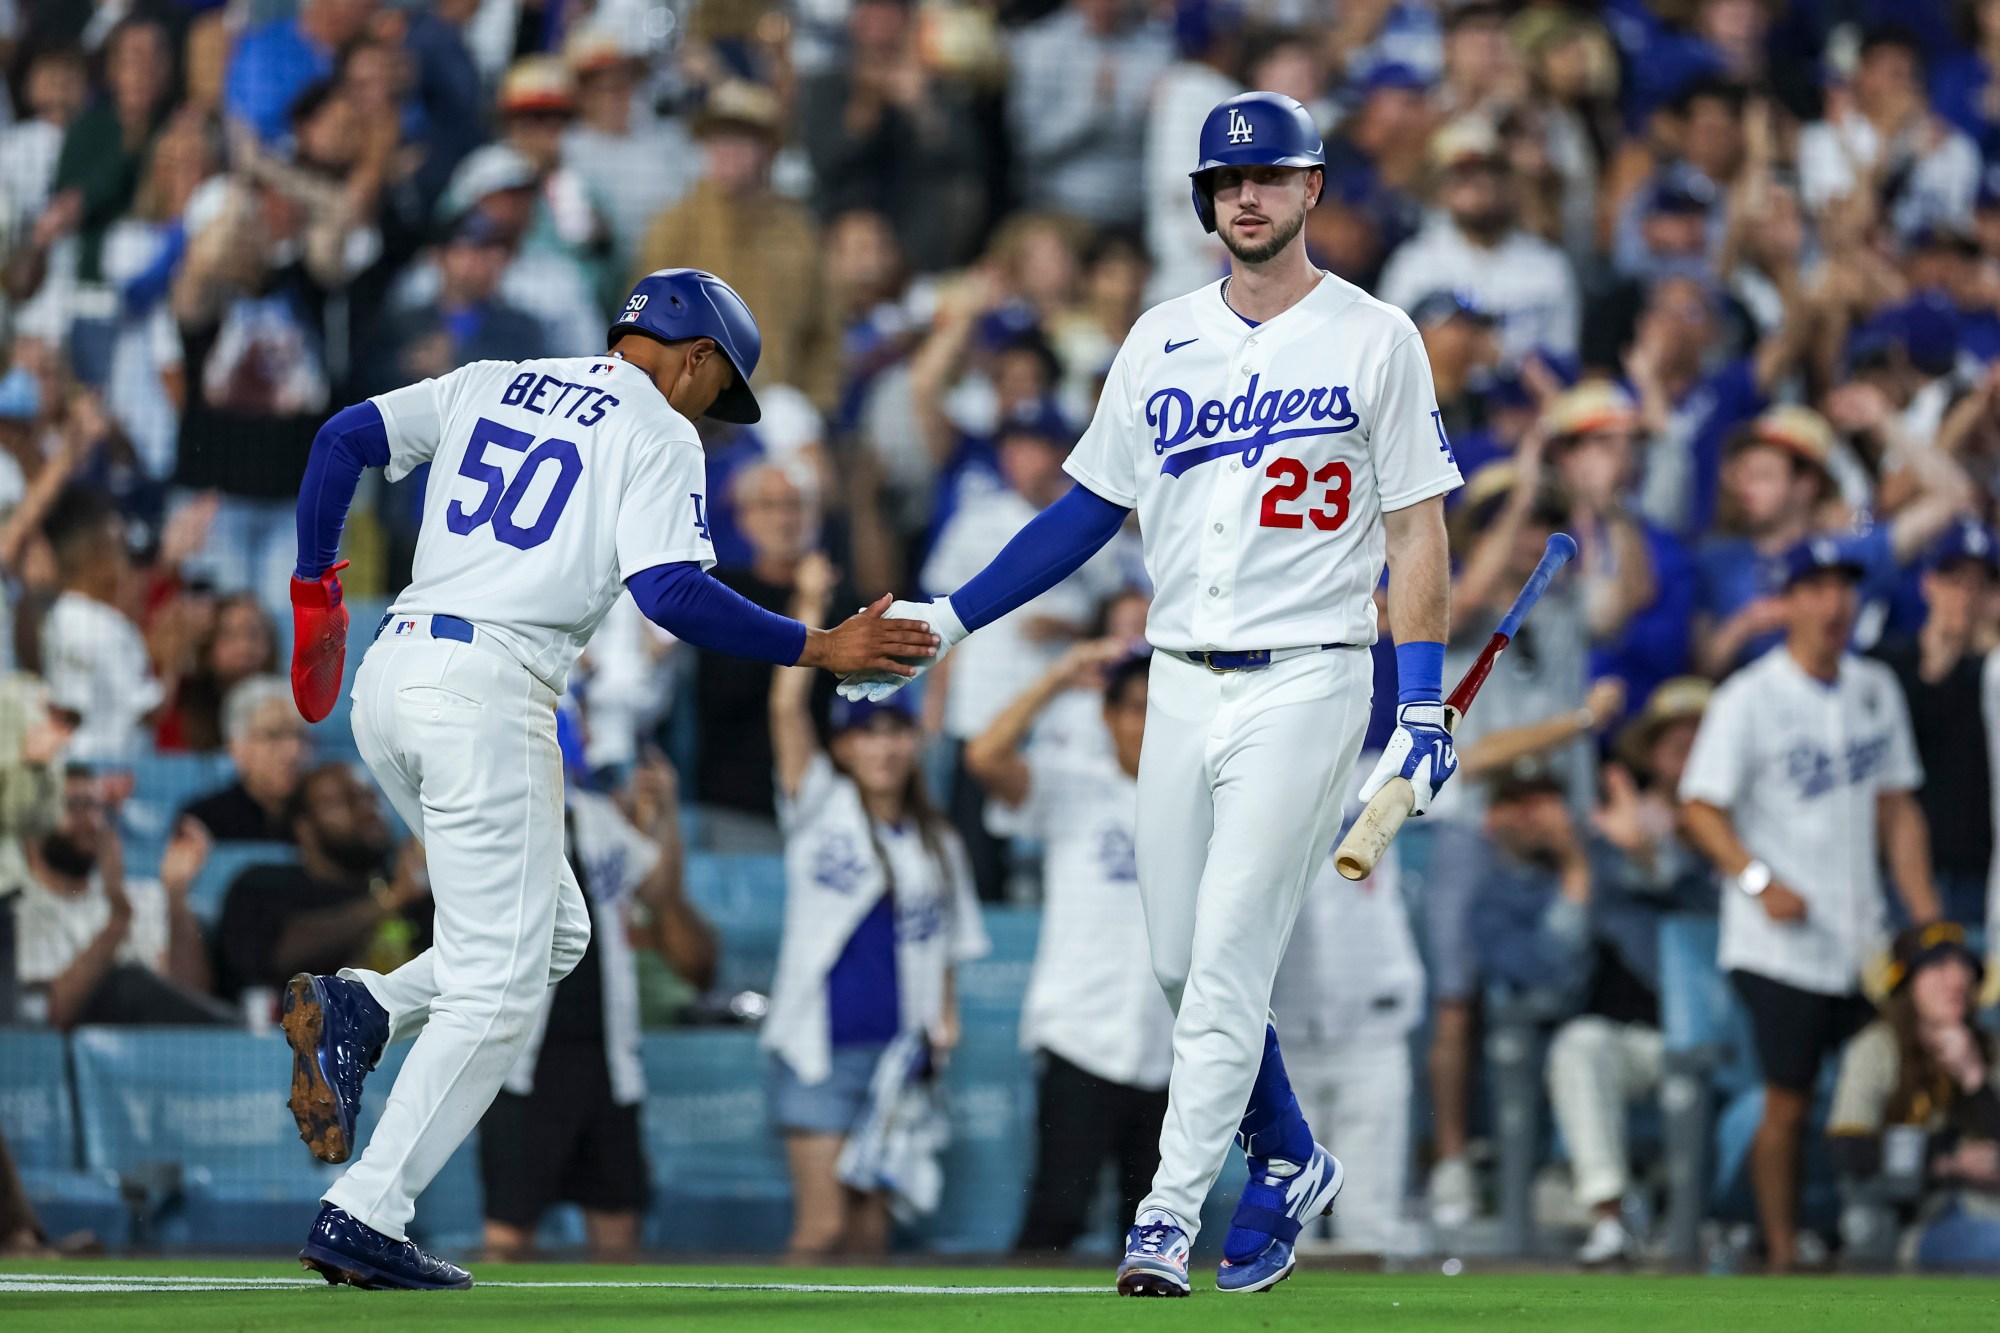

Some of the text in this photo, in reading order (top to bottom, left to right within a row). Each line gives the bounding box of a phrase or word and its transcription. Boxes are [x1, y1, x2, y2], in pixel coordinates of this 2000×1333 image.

[1227, 109, 1252, 144] LA
[626, 295, 648, 310] 50
[501, 372, 620, 427] BETTS
[1146, 373, 1359, 479] Dodgers
[447, 417, 583, 551] 50
[1260, 457, 1351, 531] 23
